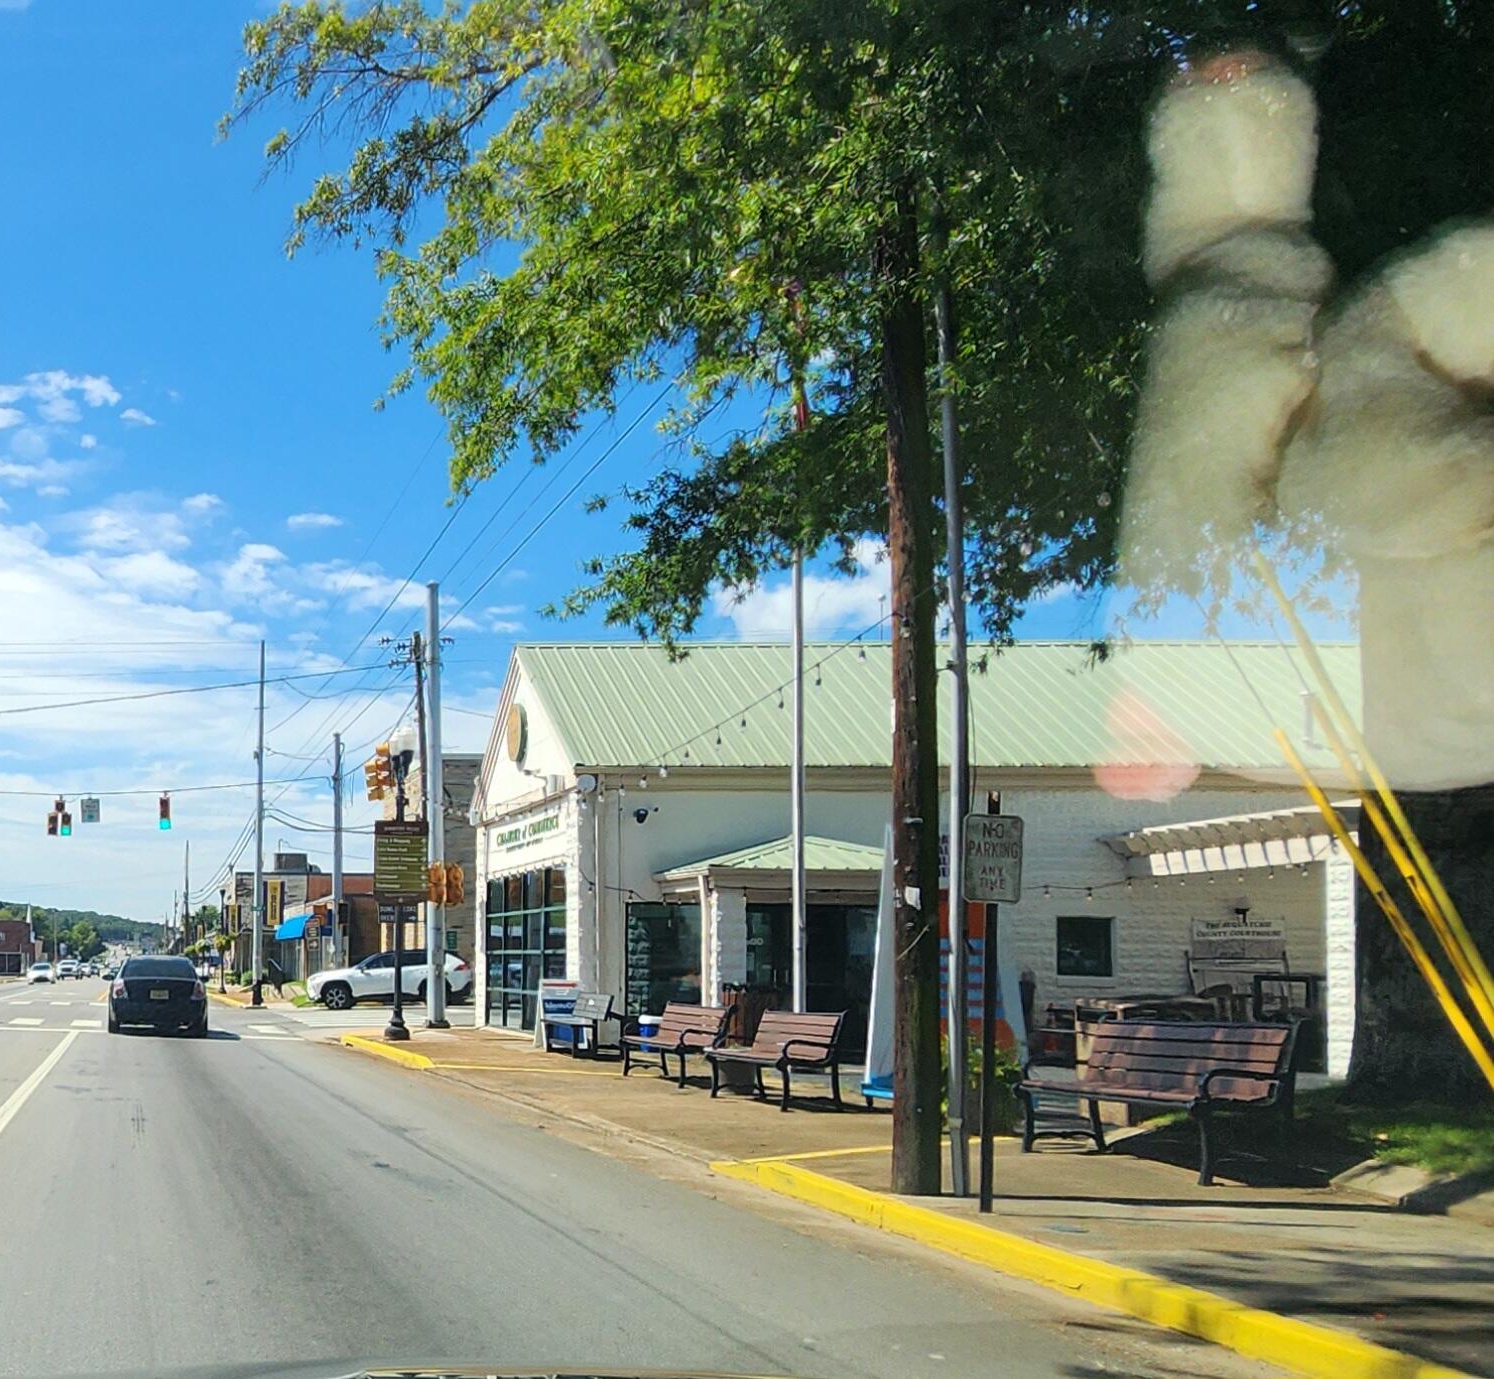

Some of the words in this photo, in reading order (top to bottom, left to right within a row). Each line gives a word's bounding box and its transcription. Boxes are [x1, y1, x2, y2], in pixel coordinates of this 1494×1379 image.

[982, 822, 1005, 839] NO
[969, 841, 1019, 859] PARKING
[981, 865, 1004, 877] ANY
[979, 877, 1005, 890] TIME
